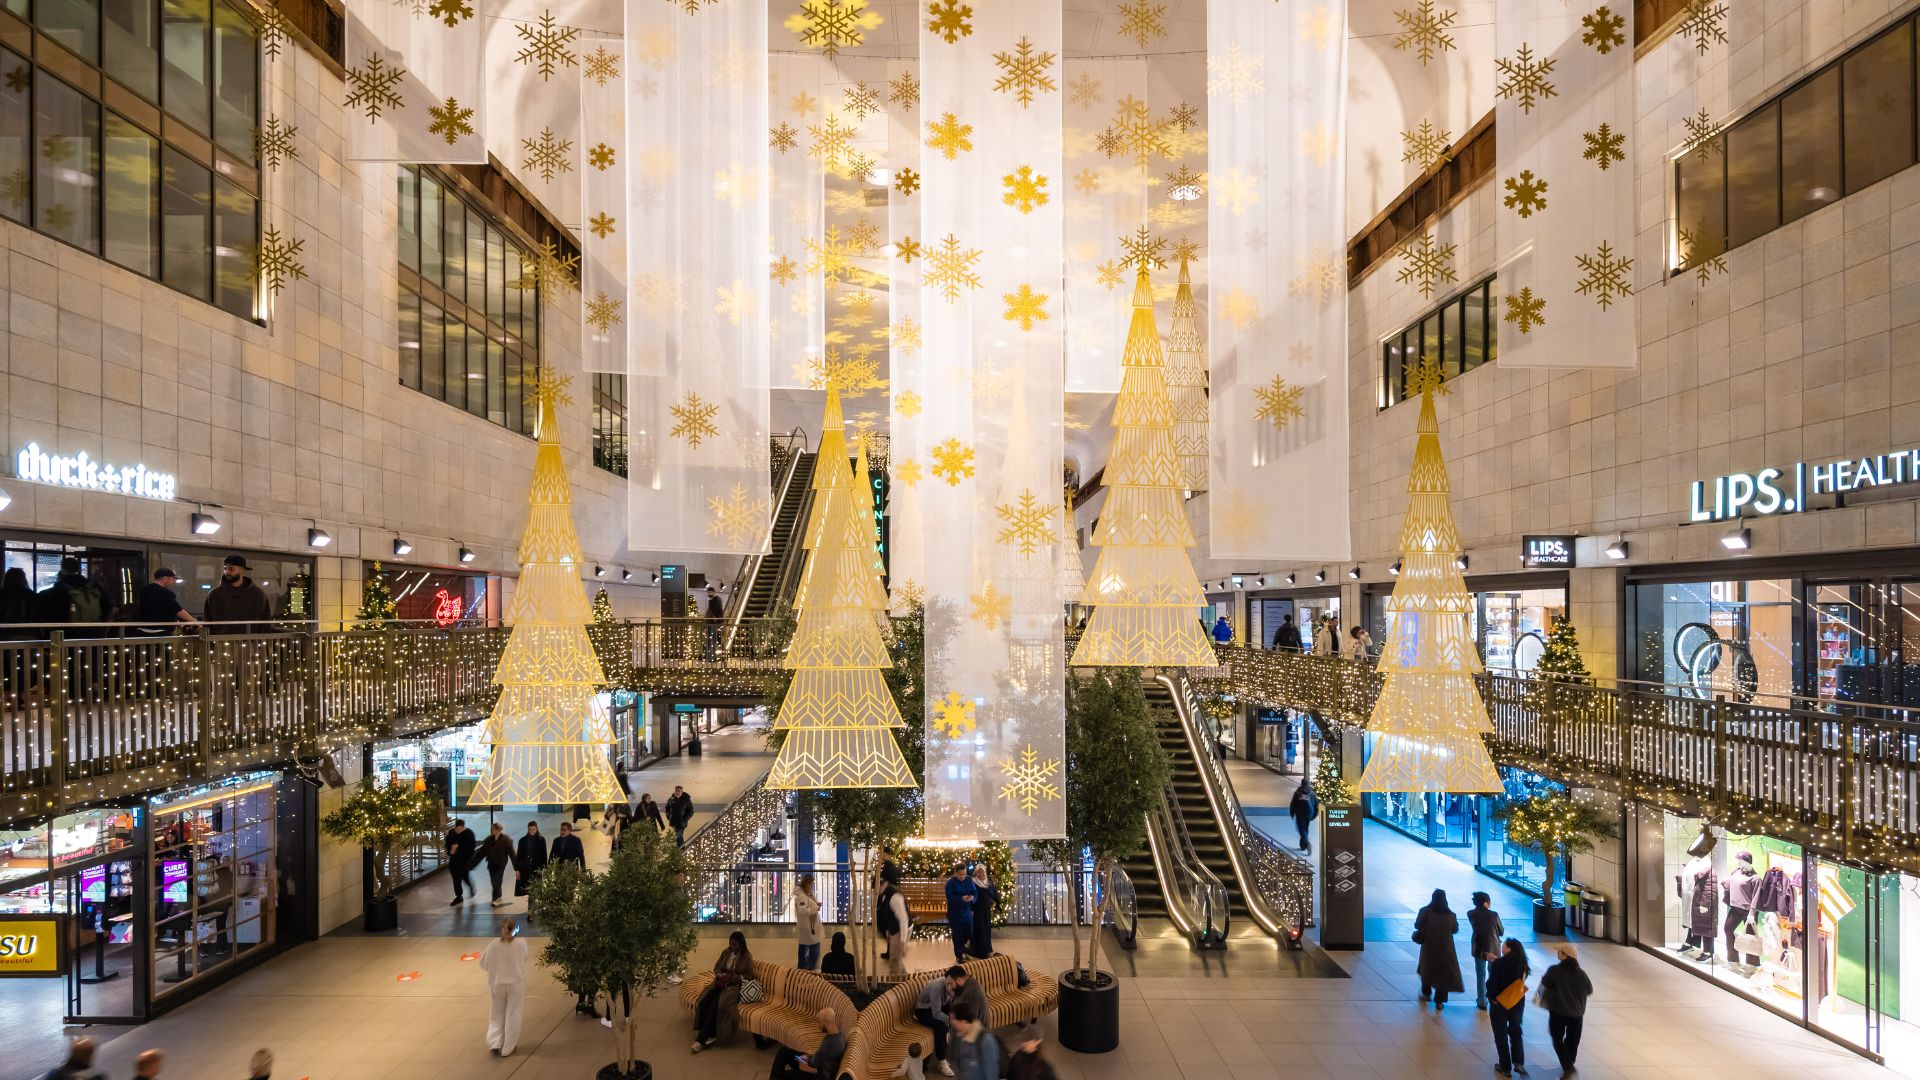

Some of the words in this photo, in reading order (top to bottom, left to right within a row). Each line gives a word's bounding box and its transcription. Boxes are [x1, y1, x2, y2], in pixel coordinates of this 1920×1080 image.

[1690, 468, 1796, 522] LIPS.
[1530, 541, 1568, 556] LIPS.
[164, 862, 187, 873] CURRY
